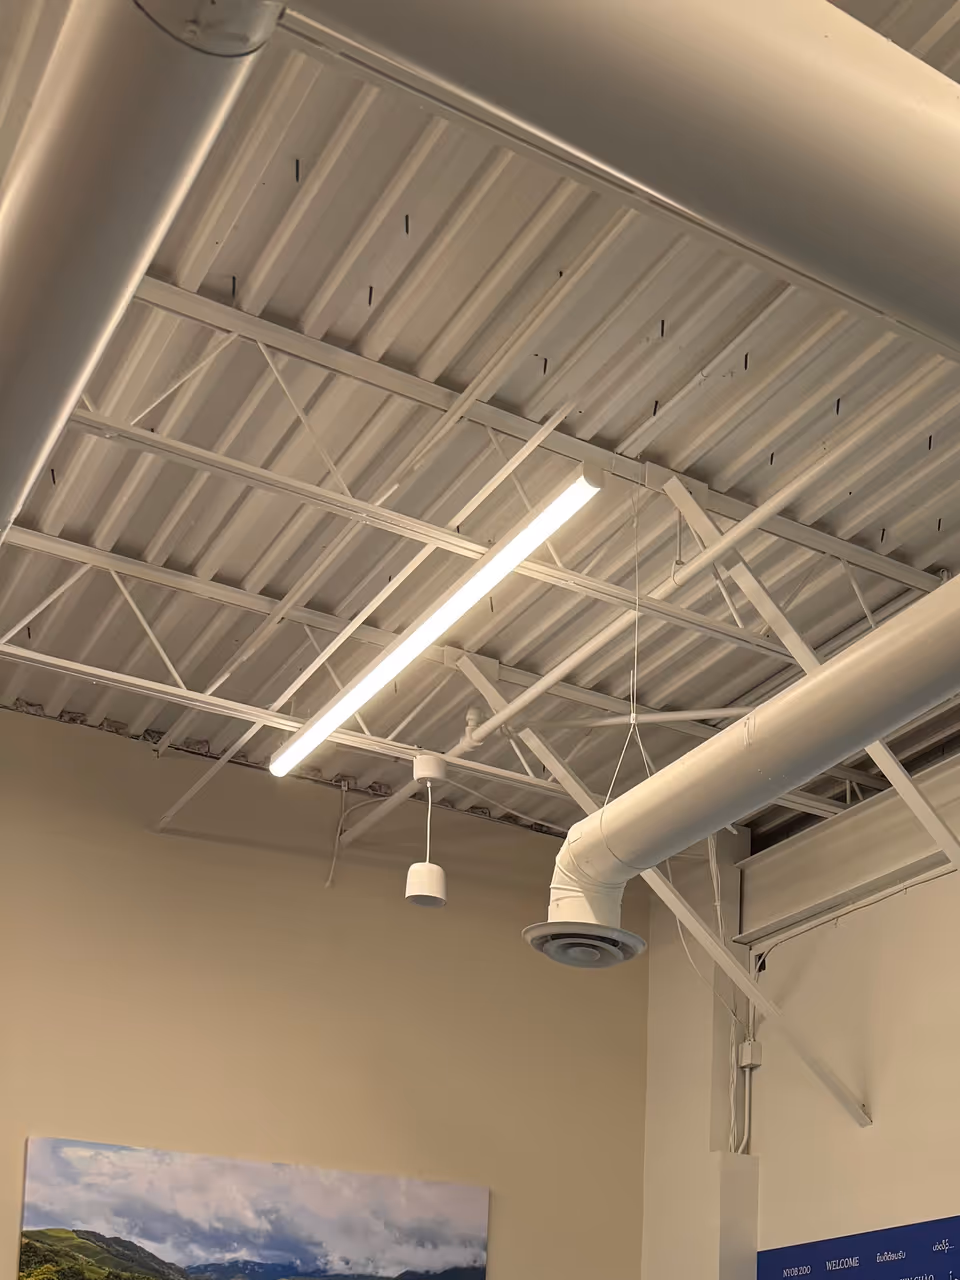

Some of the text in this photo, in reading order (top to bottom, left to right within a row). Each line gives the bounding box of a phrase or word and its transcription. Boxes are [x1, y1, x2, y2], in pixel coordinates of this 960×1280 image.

[826, 1256, 860, 1271] WELCOME
[782, 1265, 811, 1277] NYOB ZOO
